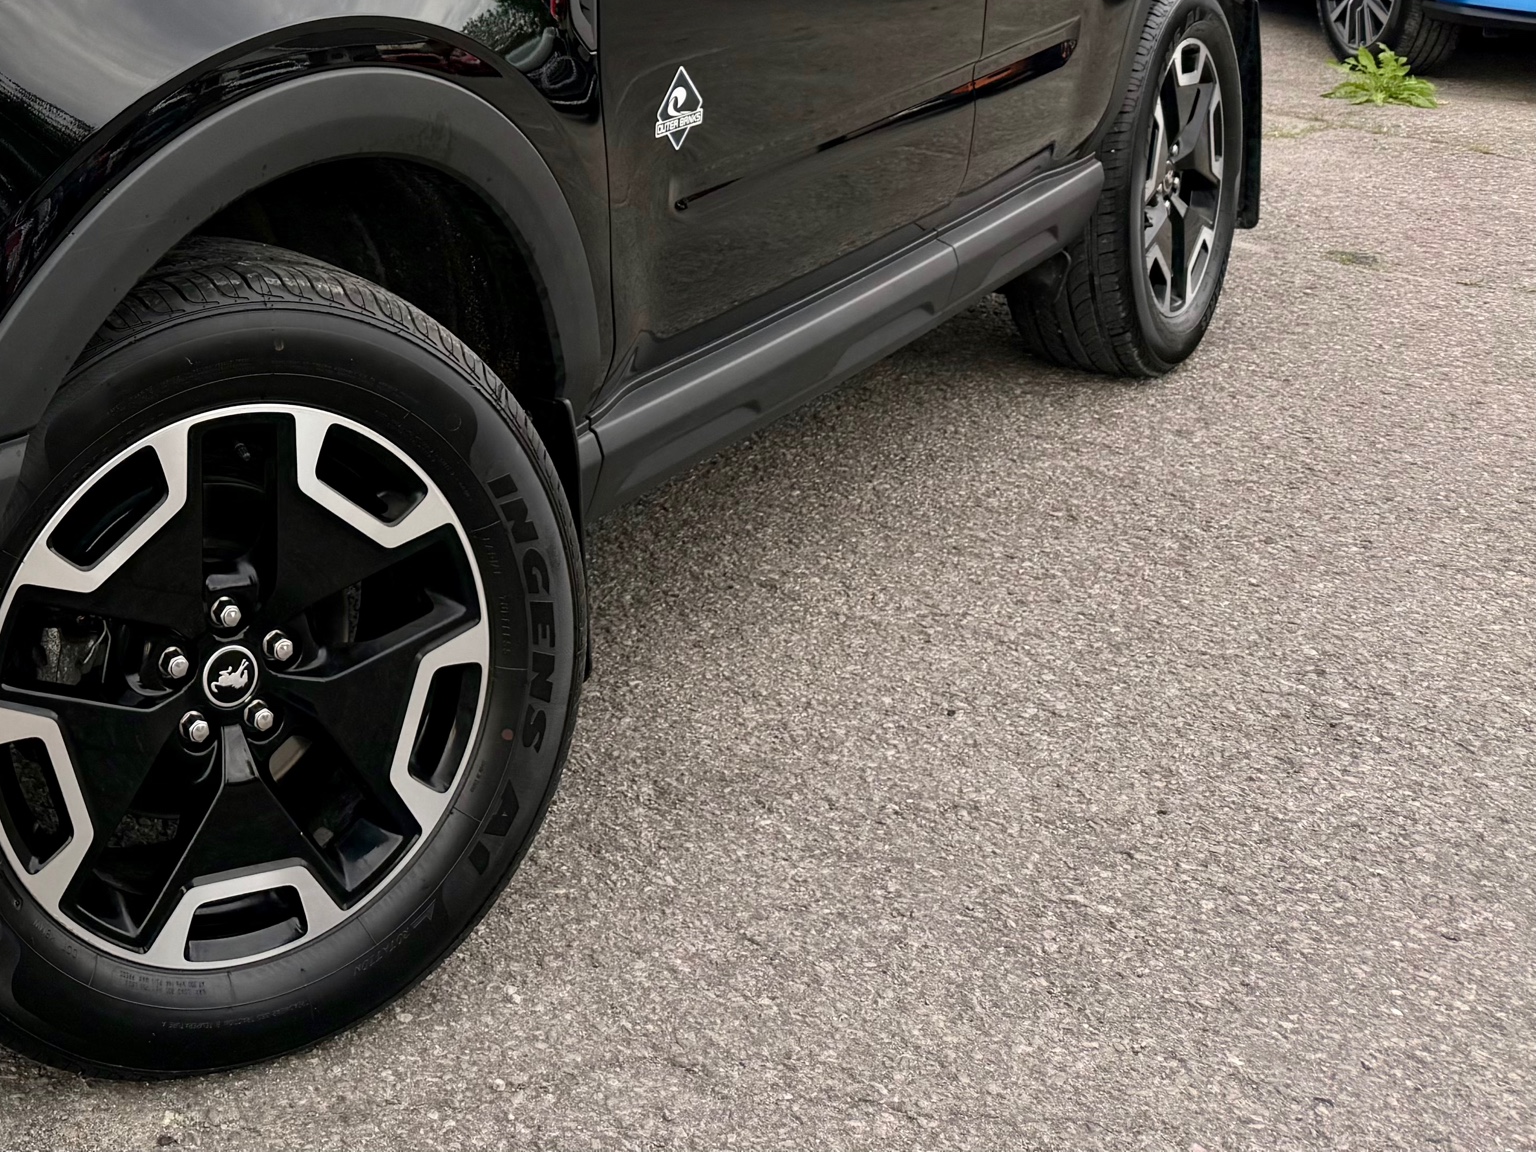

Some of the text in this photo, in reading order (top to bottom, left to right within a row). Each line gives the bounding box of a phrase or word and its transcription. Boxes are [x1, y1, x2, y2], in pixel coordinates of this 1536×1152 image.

[657, 112, 701, 134] OUTER BANKS
[487, 473, 555, 753] INGENS
